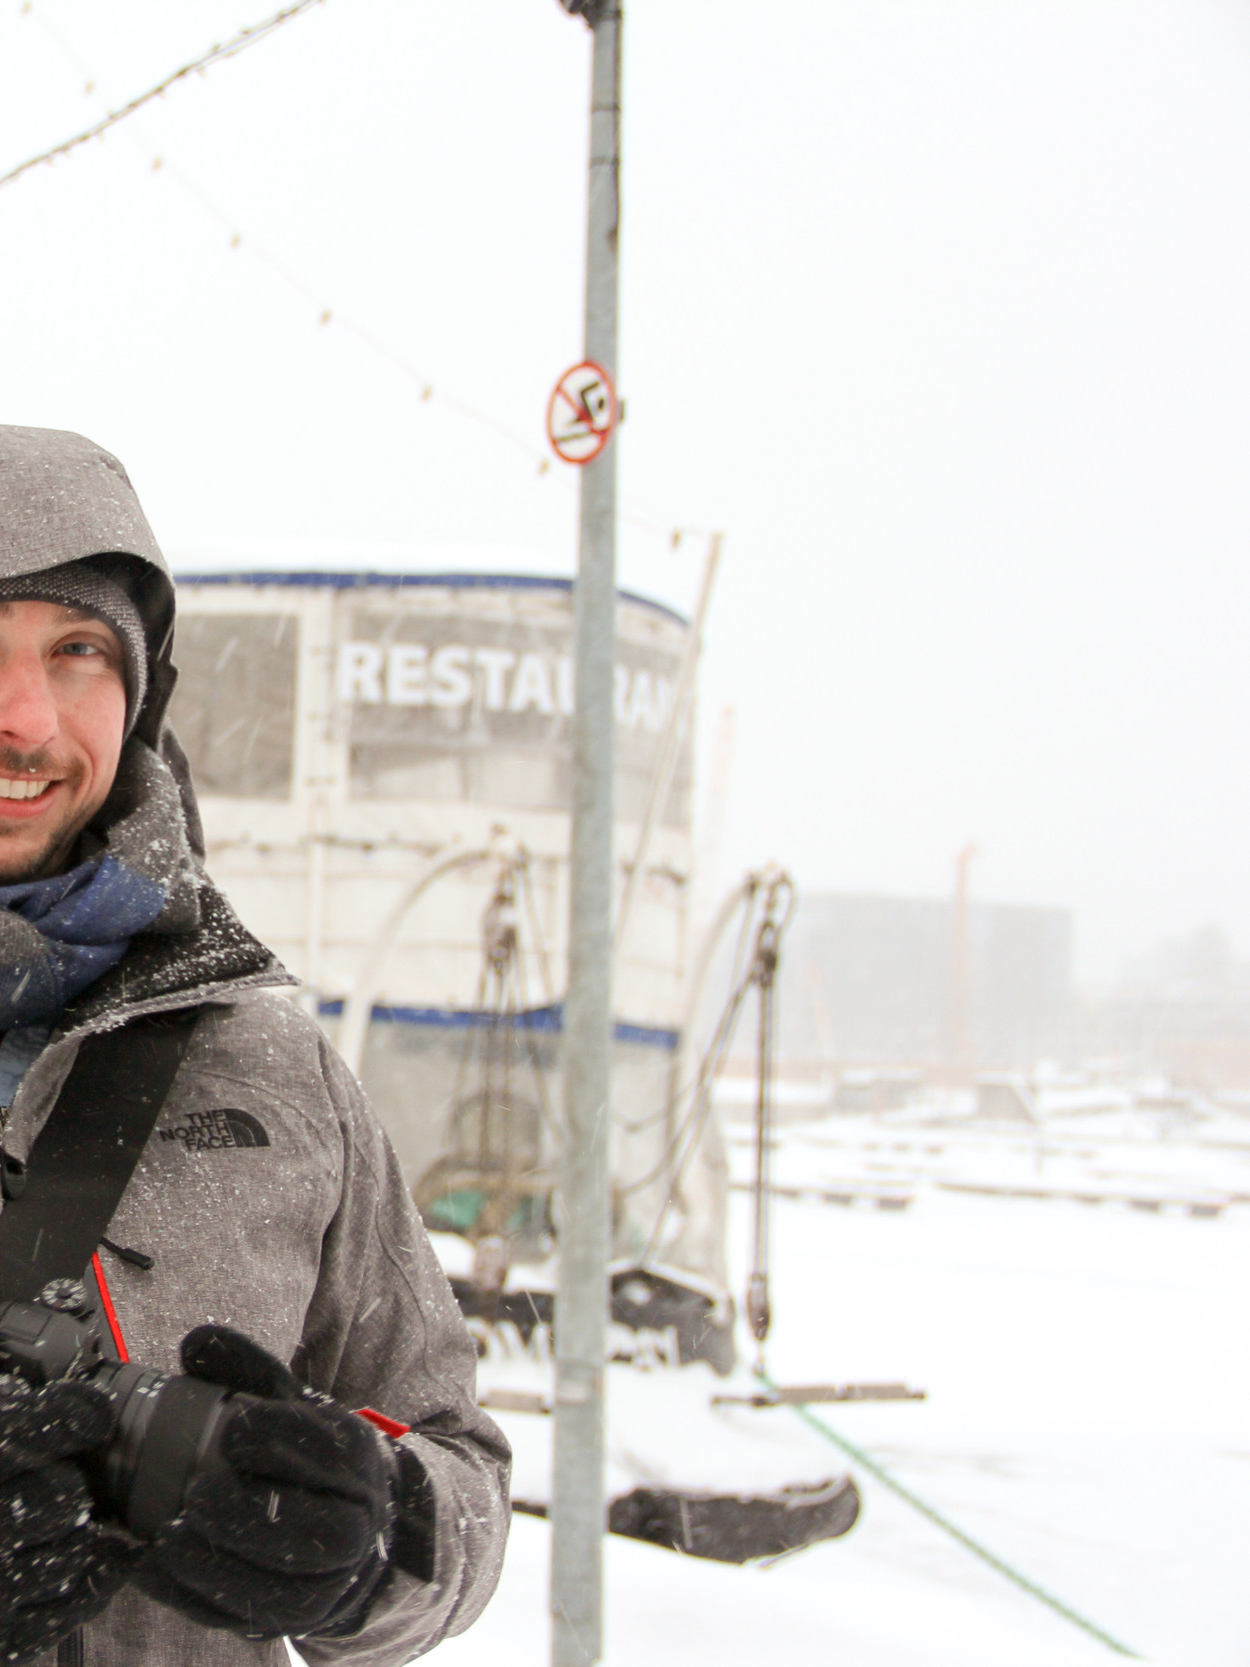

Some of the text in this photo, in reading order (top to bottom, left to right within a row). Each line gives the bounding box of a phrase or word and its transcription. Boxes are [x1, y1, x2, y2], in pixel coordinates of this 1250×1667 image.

[184, 1109, 226, 1126] THE
[159, 1121, 232, 1142] NORTH
[184, 1134, 236, 1151] FACE
